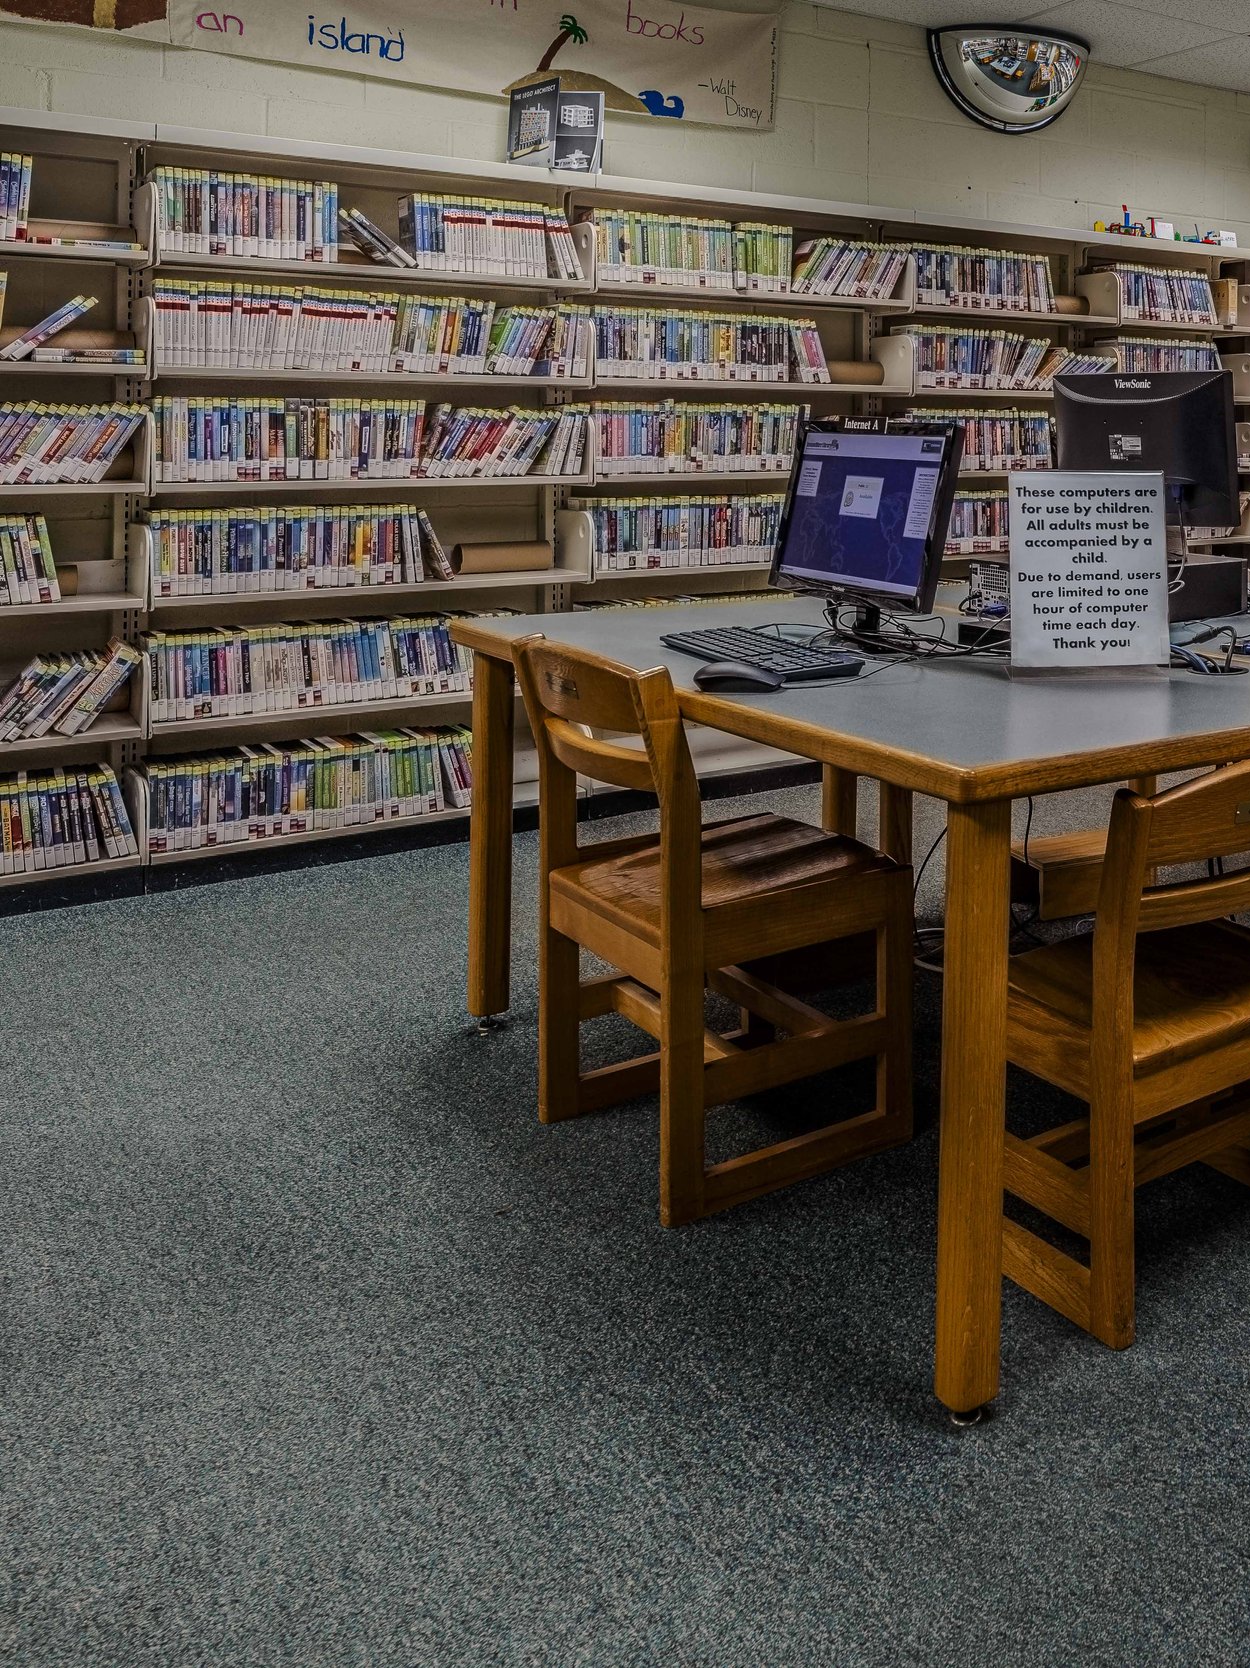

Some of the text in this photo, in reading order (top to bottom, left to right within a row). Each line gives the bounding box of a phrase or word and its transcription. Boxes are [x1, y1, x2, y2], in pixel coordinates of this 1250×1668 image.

[196, 0, 704, 61] an island books
[522, 91, 533, 99] LEGO
[534, 84, 556, 95] ARCHITECT
[725, 95, 763, 125] Disney
[1114, 379, 1152, 389] ViewSonic
[844, 418, 879, 430] Internet A
[1015, 486, 1157, 500] These computers are
[1021, 502, 1153, 516] for use by children.
[1026, 519, 1150, 531] All adults must be
[1024, 535, 1152, 549] accompanied by a
[1072, 552, 1108, 564] child.
[1018, 569, 1161, 582] Due to demand, users
[1031, 586, 1149, 598] are limited to one
[1033, 602, 1149, 615] hour of computer
[1042, 618, 1140, 631] time each day.
[1052, 637, 1131, 651] Thank you!
